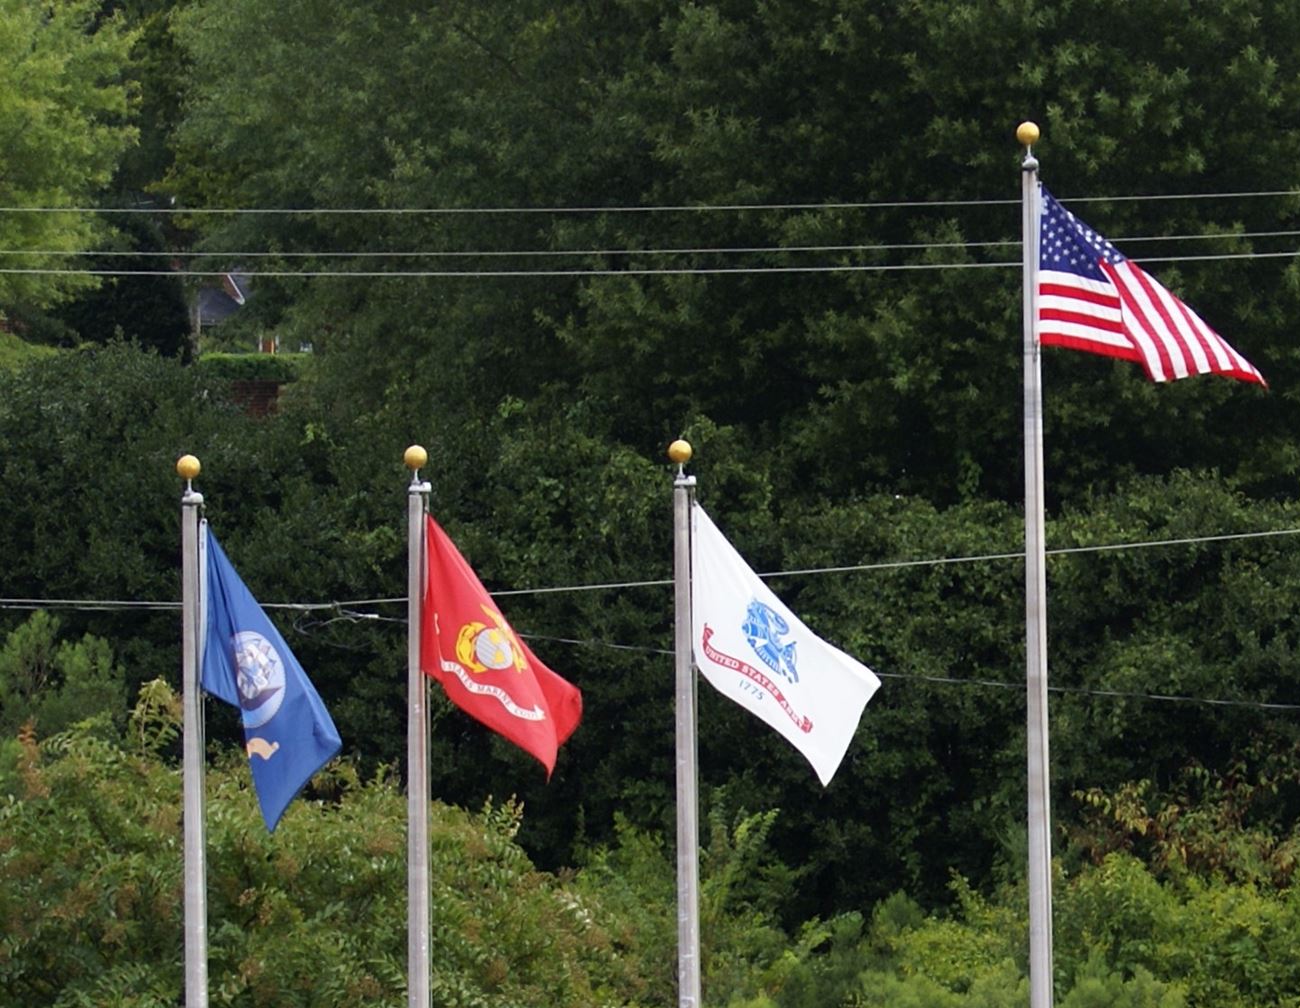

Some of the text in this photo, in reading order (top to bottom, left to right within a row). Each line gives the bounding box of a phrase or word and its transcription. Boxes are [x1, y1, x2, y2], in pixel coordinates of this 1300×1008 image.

[447, 663, 473, 689] STATES
[477, 685, 512, 706] MARINE
[705, 645, 740, 668] UNITED
[741, 665, 779, 698] STATES
[739, 679, 765, 700] 1775
